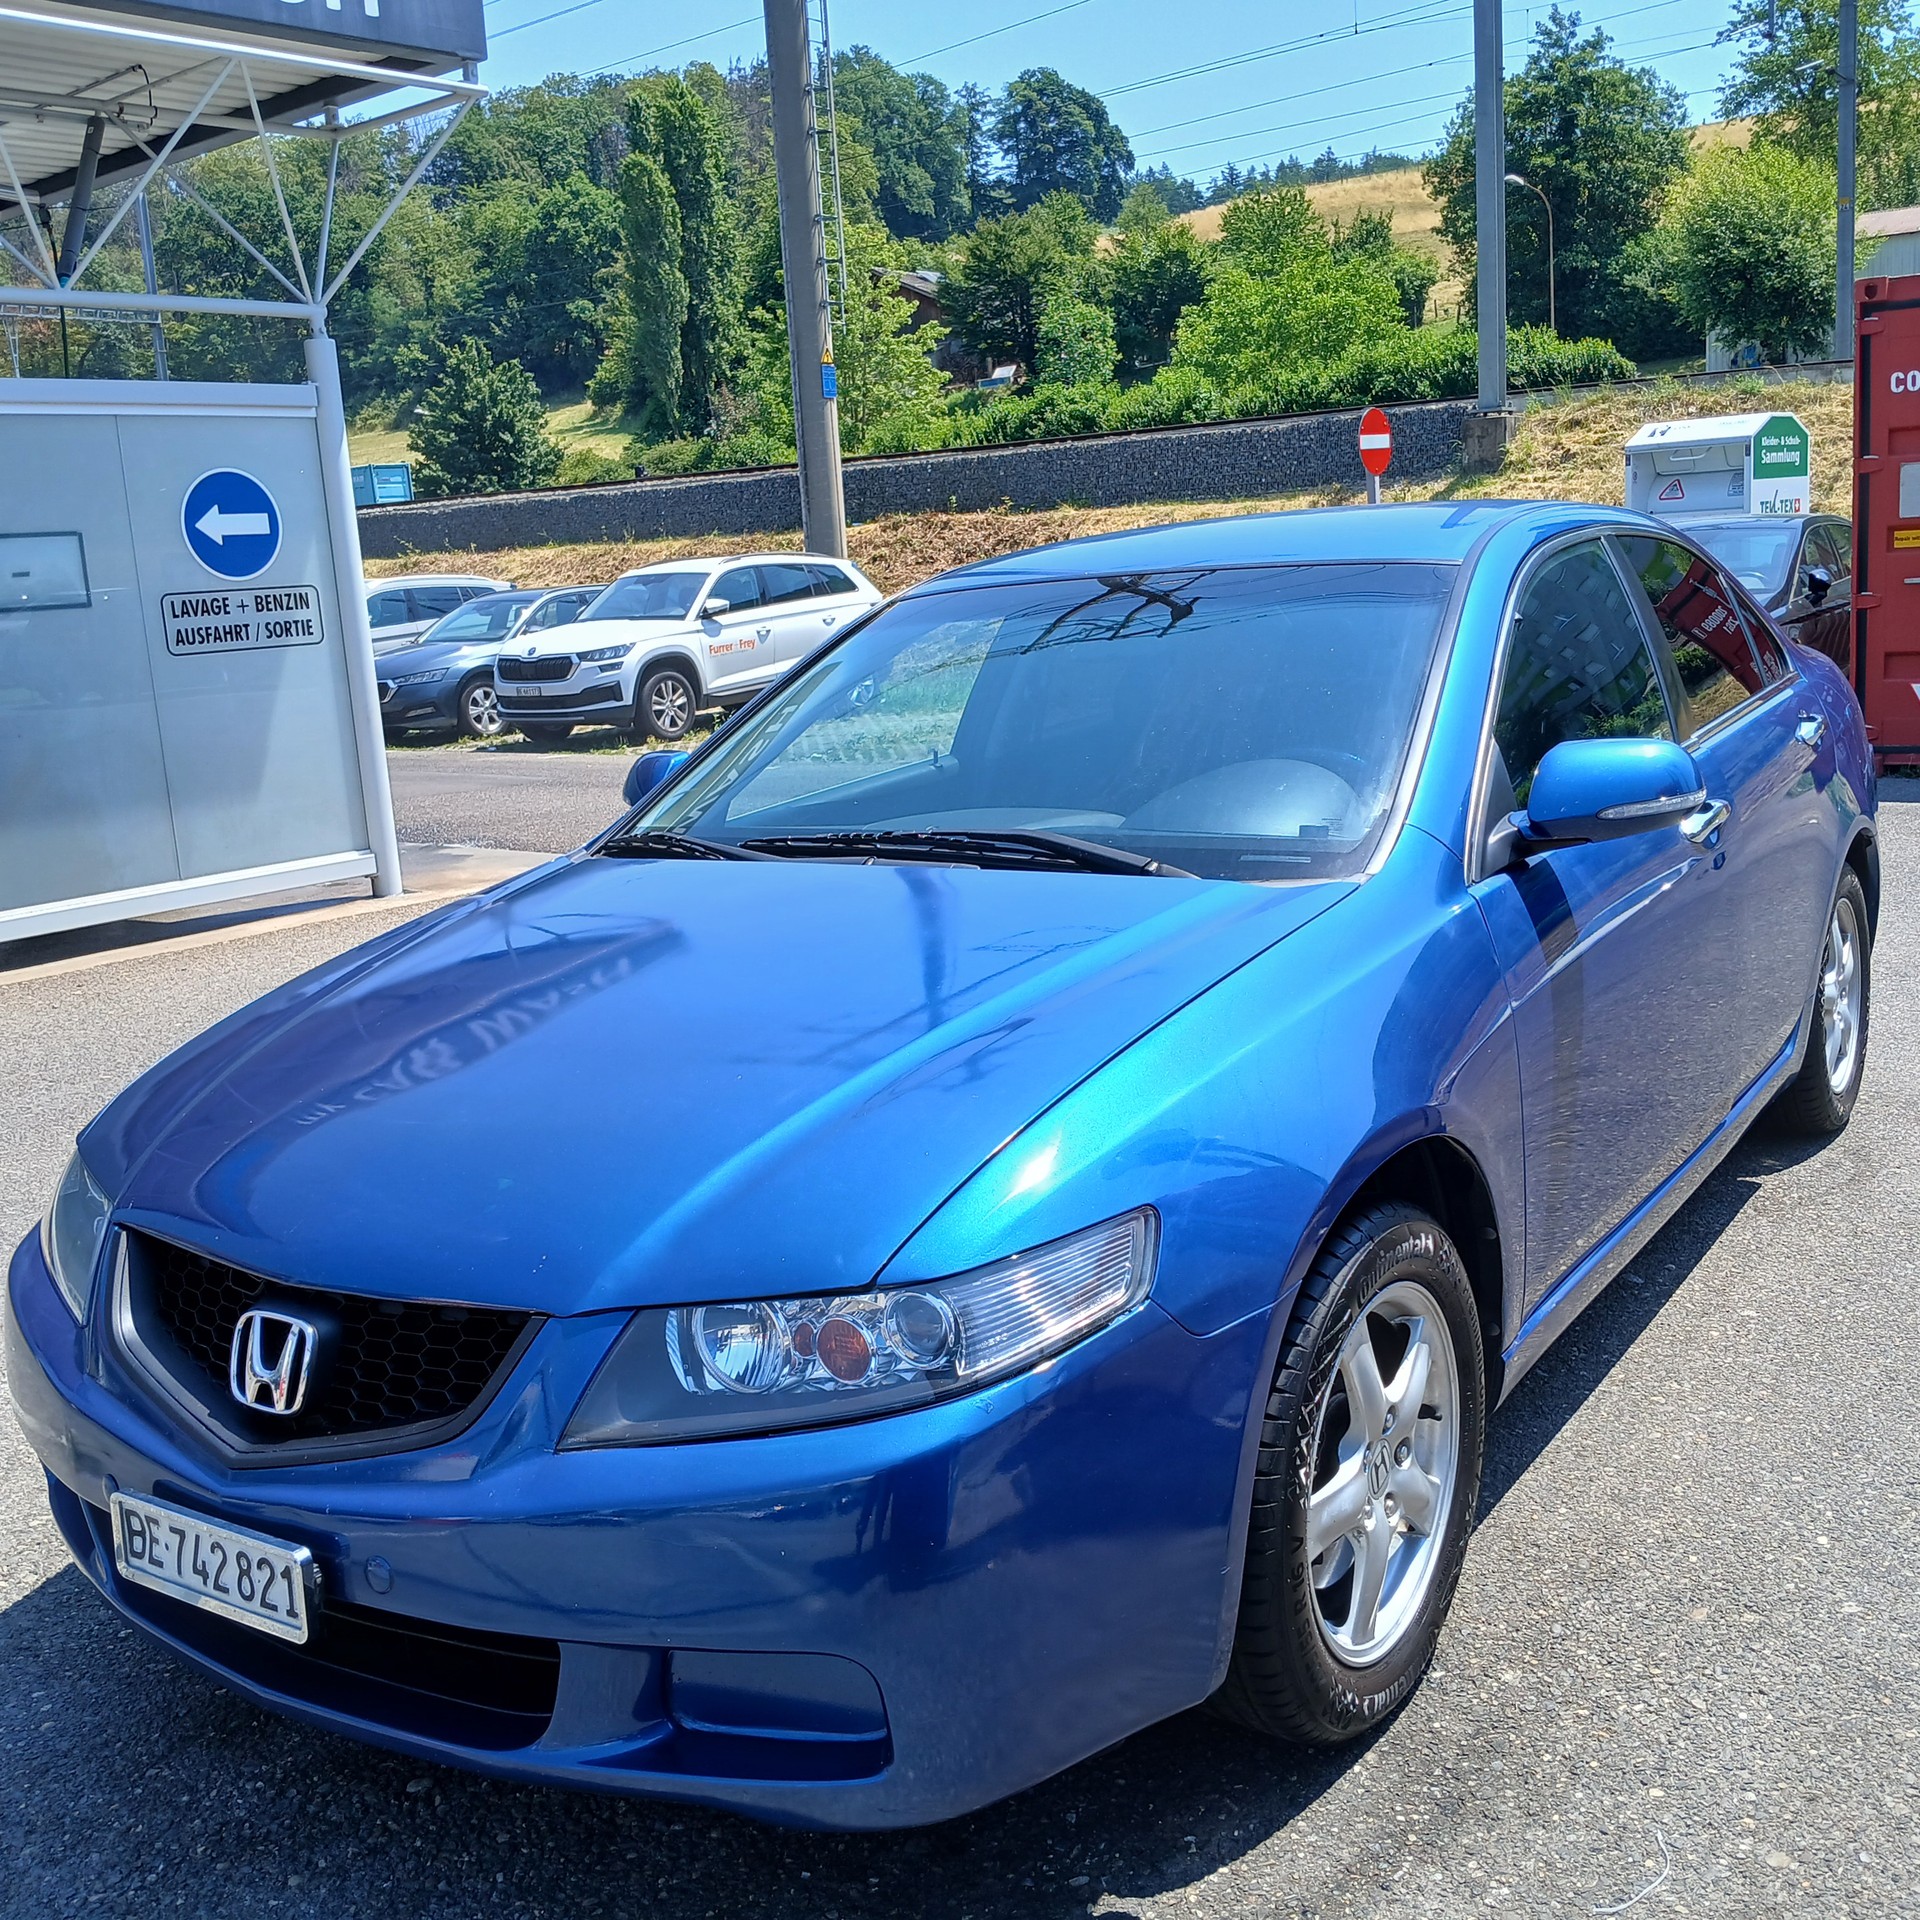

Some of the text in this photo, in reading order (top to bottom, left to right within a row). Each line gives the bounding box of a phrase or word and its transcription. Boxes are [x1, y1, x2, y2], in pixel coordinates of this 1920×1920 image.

[1761, 435, 1780, 446] Kleider-
[1761, 447, 1800, 466] Sammlung
[170, 592, 310, 619] LAVAGE + BENZIN
[175, 619, 314, 646] AUSFAHRT / SORTIE
[709, 642, 733, 655] Furrer
[739, 639, 756, 650] Frey
